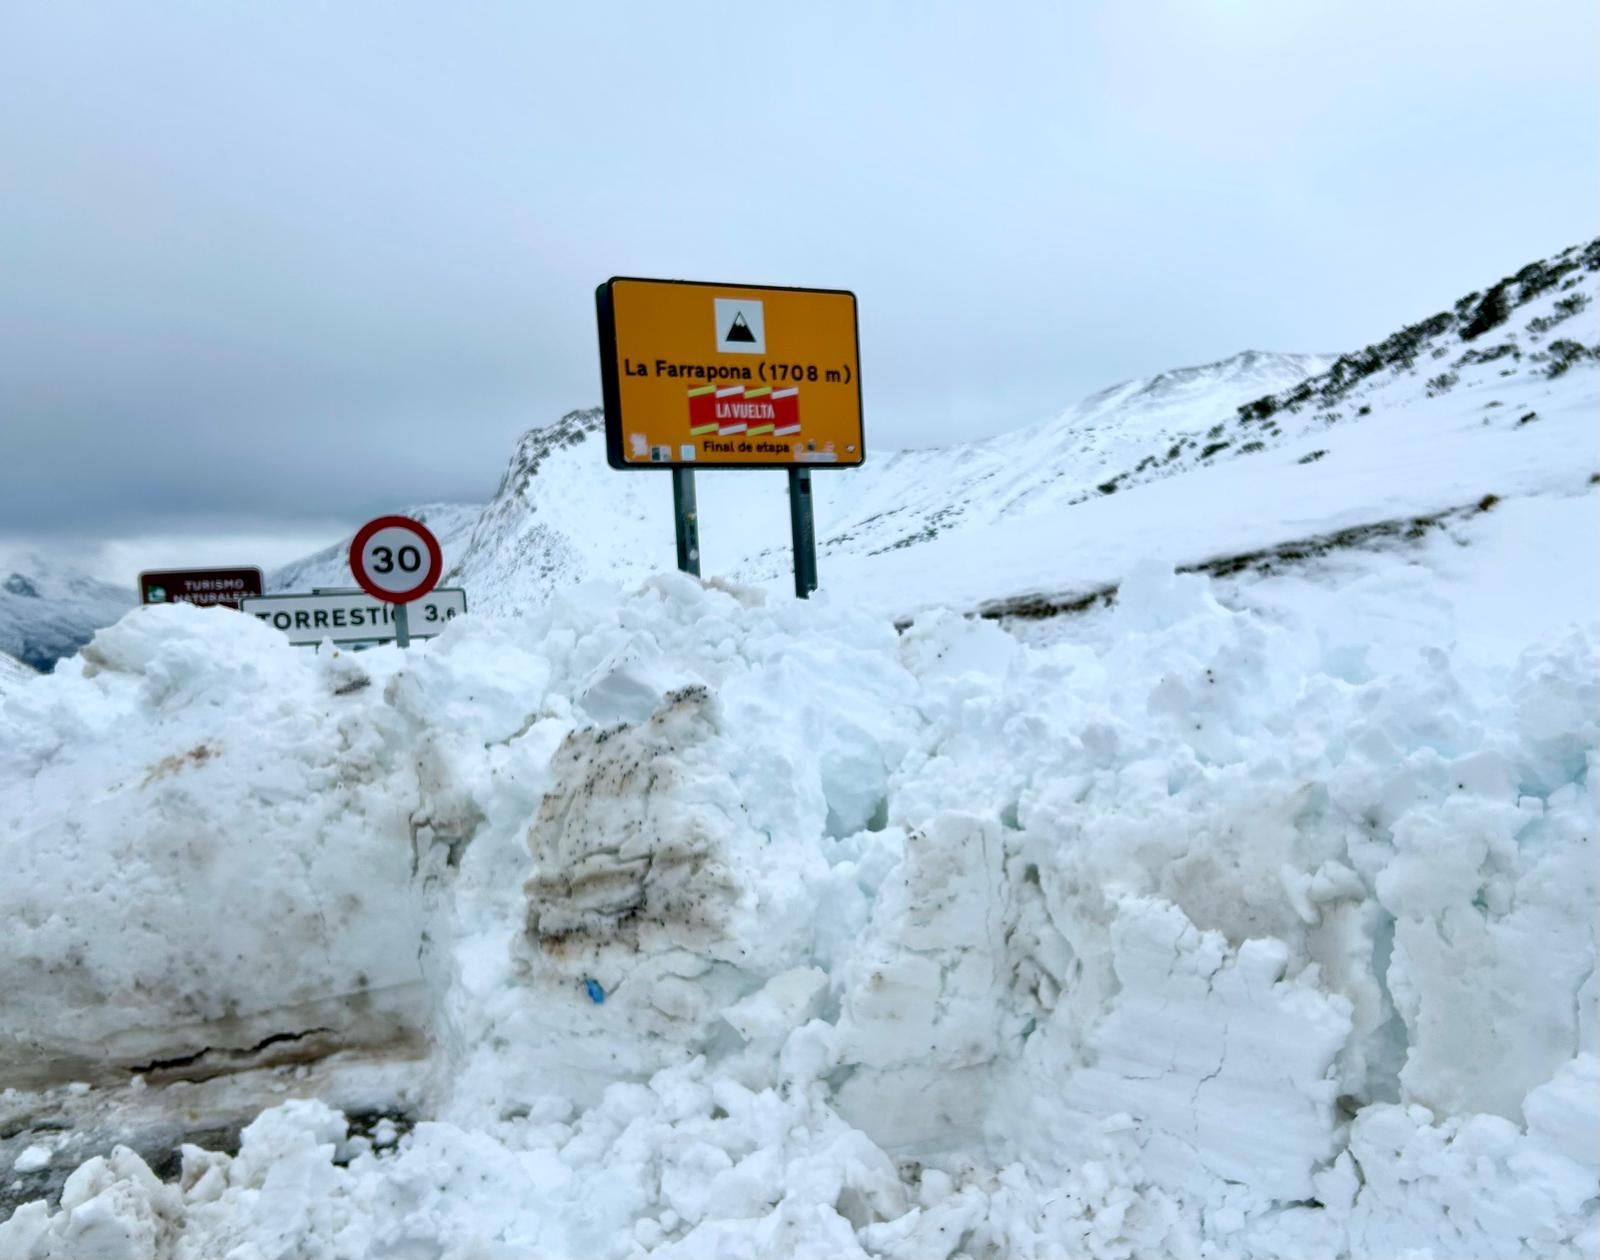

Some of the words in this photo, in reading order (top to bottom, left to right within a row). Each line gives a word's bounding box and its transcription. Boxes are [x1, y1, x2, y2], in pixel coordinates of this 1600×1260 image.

[625, 359, 647, 377] La
[655, 360, 752, 383] Farrapona
[758, 362, 818, 383] (1708
[826, 365, 852, 384] m)
[715, 403, 732, 419] LA
[732, 403, 775, 419] VUELTA
[703, 441, 734, 453] Final
[739, 442, 753, 453] de
[756, 443, 790, 456] etapa
[371, 546, 422, 574] 30
[184, 578, 244, 591] TURISMO
